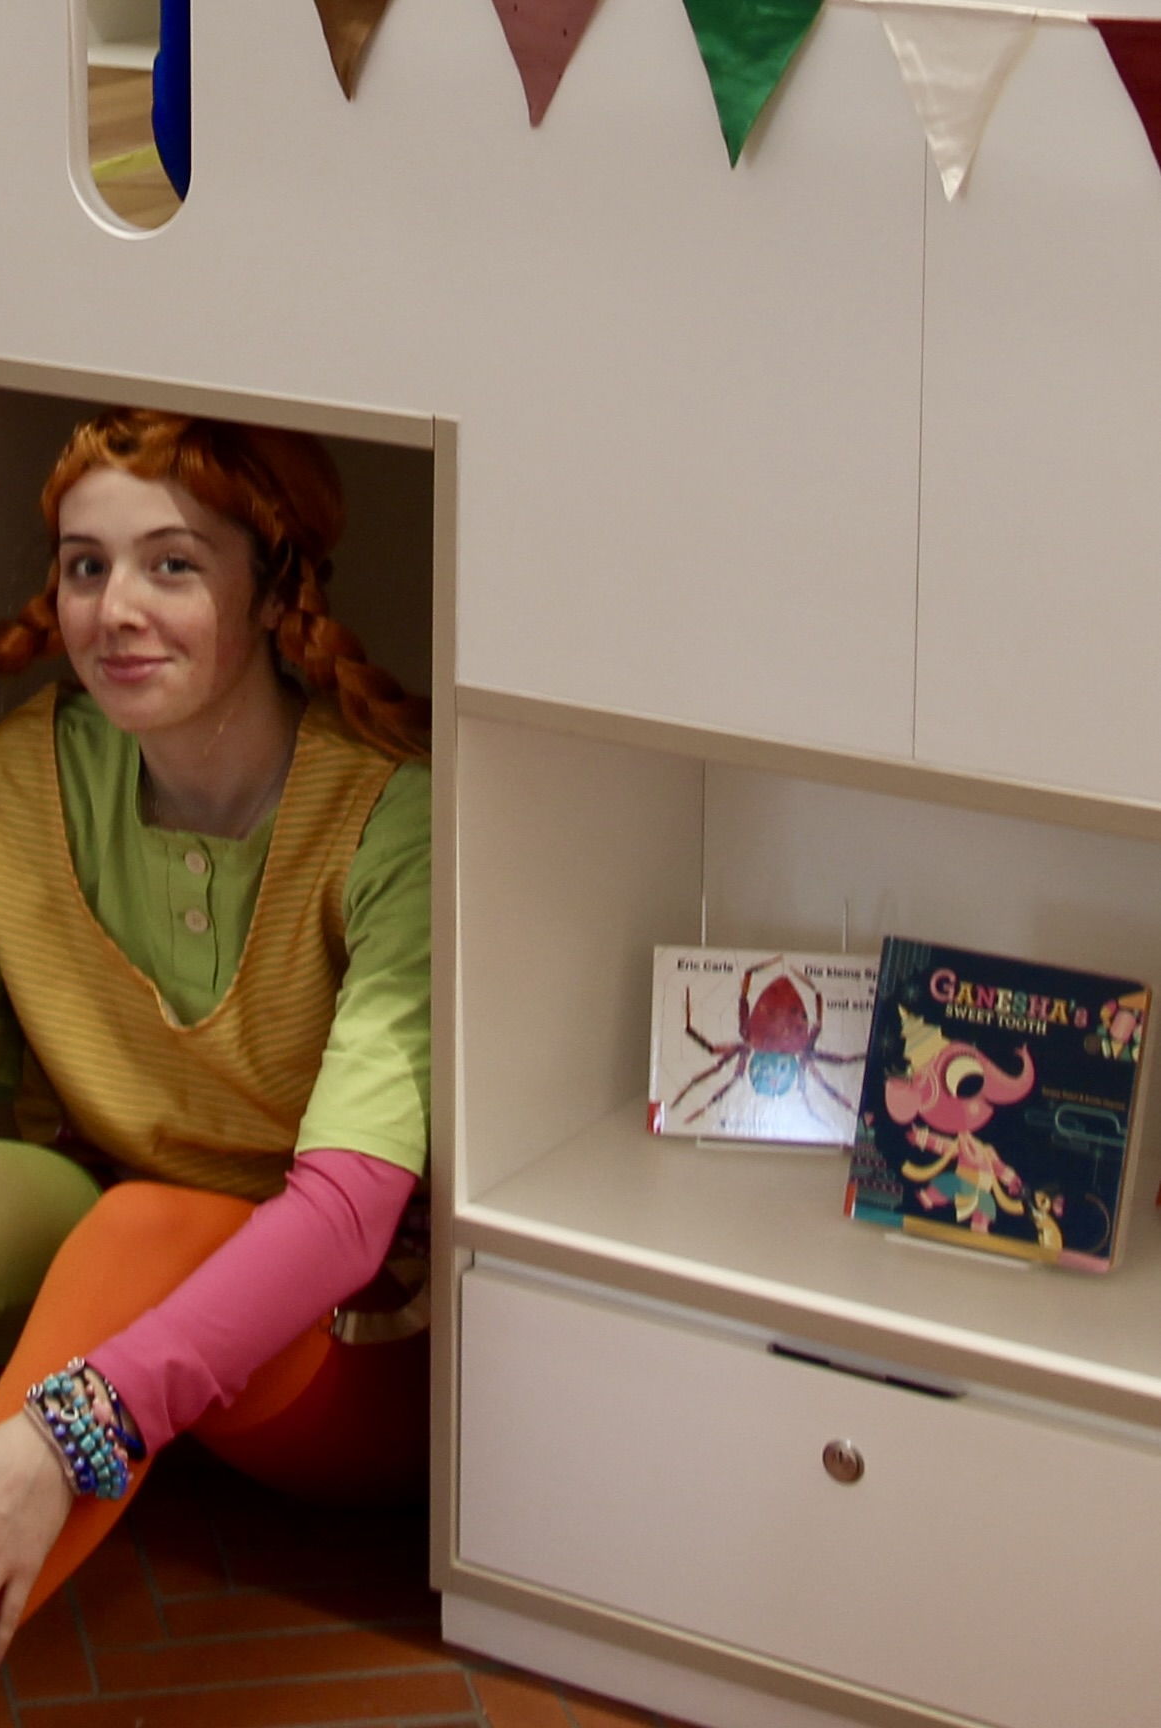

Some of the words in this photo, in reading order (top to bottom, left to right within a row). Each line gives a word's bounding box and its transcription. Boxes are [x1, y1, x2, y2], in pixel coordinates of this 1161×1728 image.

[677, 959, 700, 971] Eric
[703, 959, 734, 972] Carle
[804, 963, 823, 976] Die
[826, 964, 861, 978] kleine
[826, 997, 849, 1010] und
[945, 1004, 992, 1026] SWEET
[998, 1015, 1048, 1036] TOOTH
